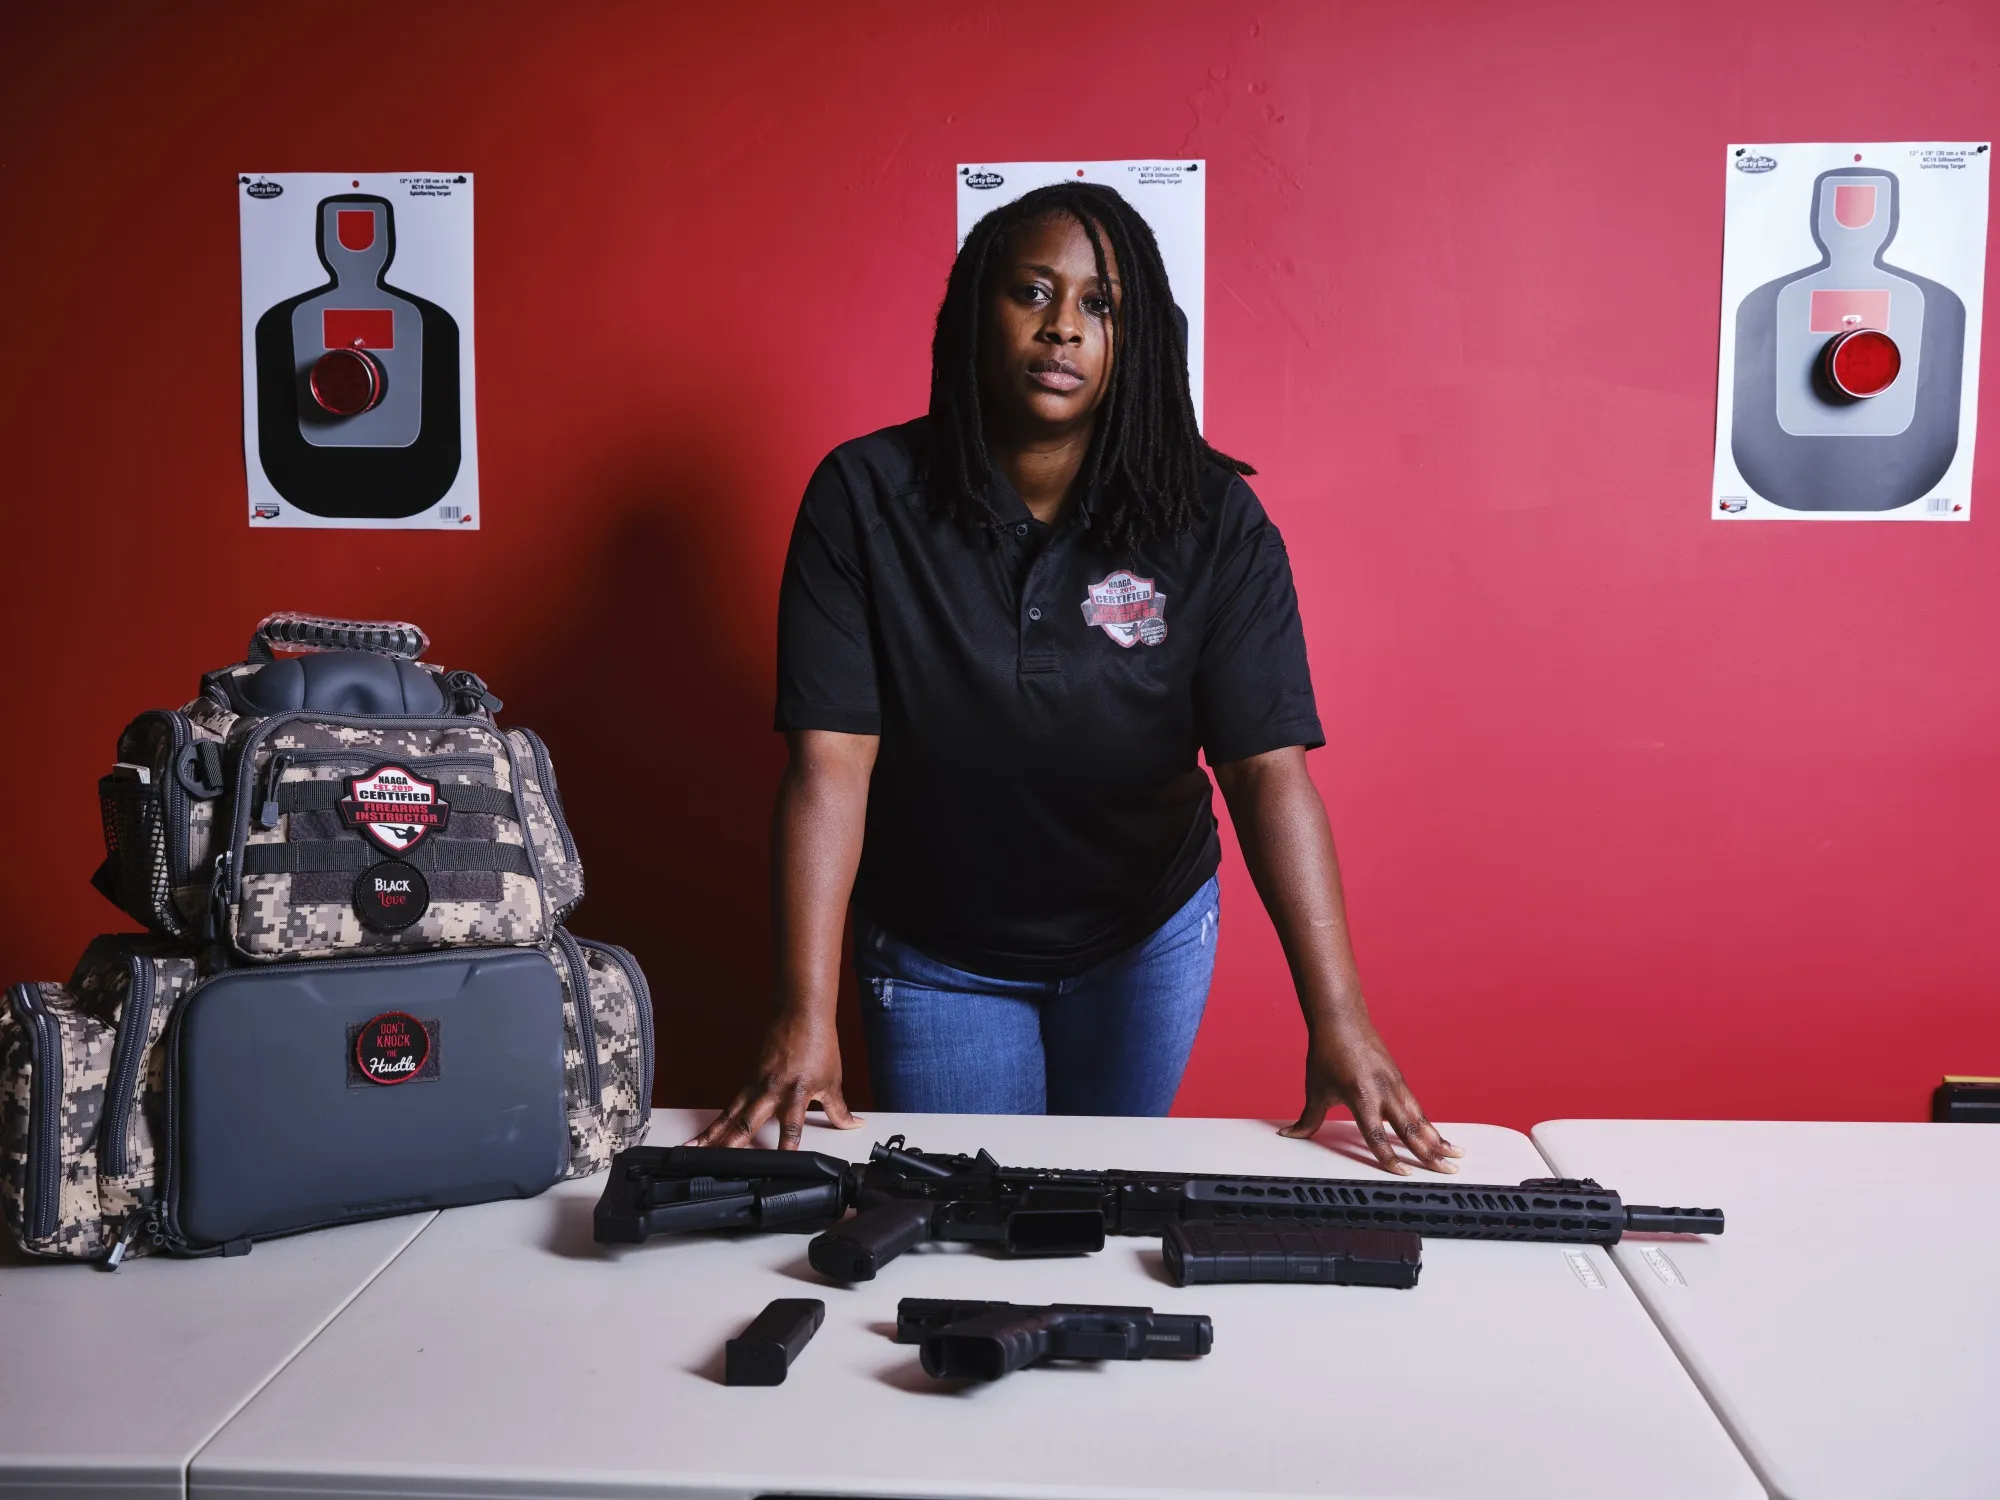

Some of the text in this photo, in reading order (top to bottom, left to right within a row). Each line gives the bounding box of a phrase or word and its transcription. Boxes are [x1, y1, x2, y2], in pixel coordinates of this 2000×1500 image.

[1738, 158, 1774, 168] Dirty Bird
[968, 176, 986, 184] Dirty
[250, 185, 265, 193] Dirty
[1108, 579, 1132, 588] NAAGA
[1095, 590, 1150, 603] CERTIFIED
[378, 776, 408, 785] NAAGA
[359, 790, 430, 802] CERTIFIED
[364, 803, 428, 813] FIREARMS
[356, 812, 438, 823] INSTRUCTOR
[377, 892, 406, 907] Love
[381, 1022, 405, 1034] DON'T
[377, 1035, 411, 1047] KNOCK
[369, 1056, 416, 1074] Hustle
